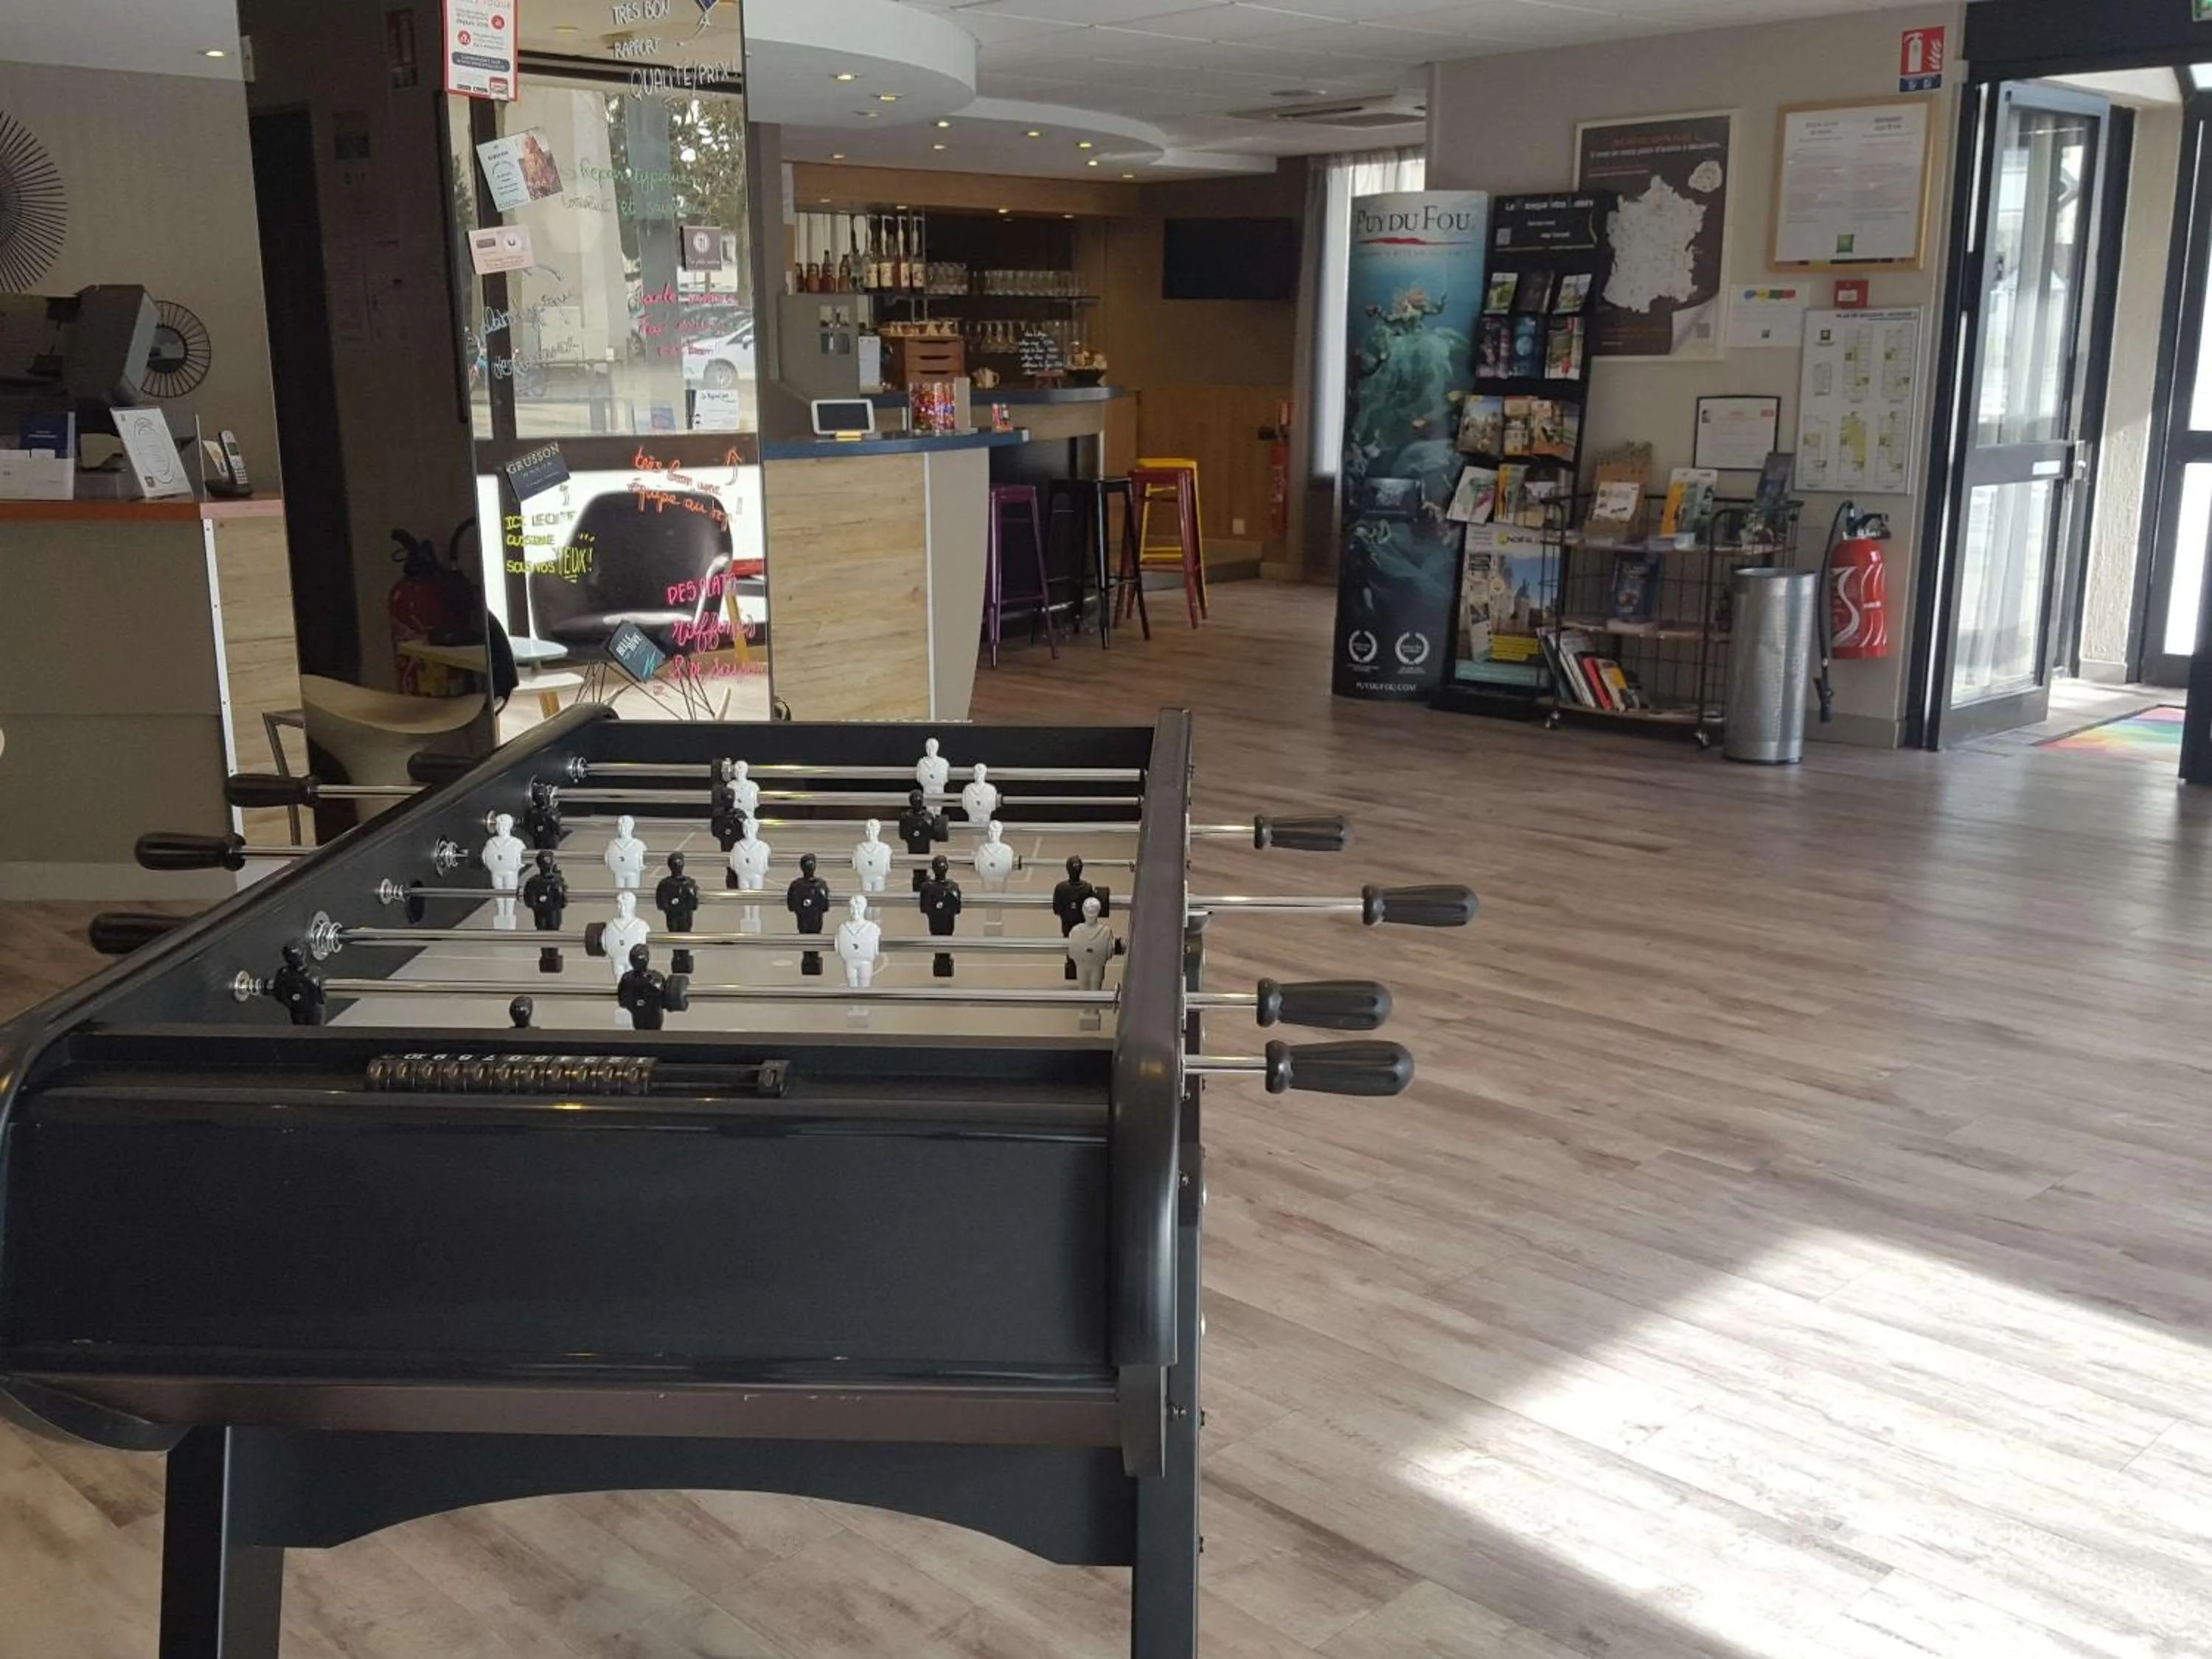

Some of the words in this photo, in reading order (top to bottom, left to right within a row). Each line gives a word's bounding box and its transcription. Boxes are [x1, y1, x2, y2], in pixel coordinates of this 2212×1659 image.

[613, 38, 661, 59] RAPPORT
[507, 442, 560, 474] GRUSSON
[667, 580, 697, 605] DES
